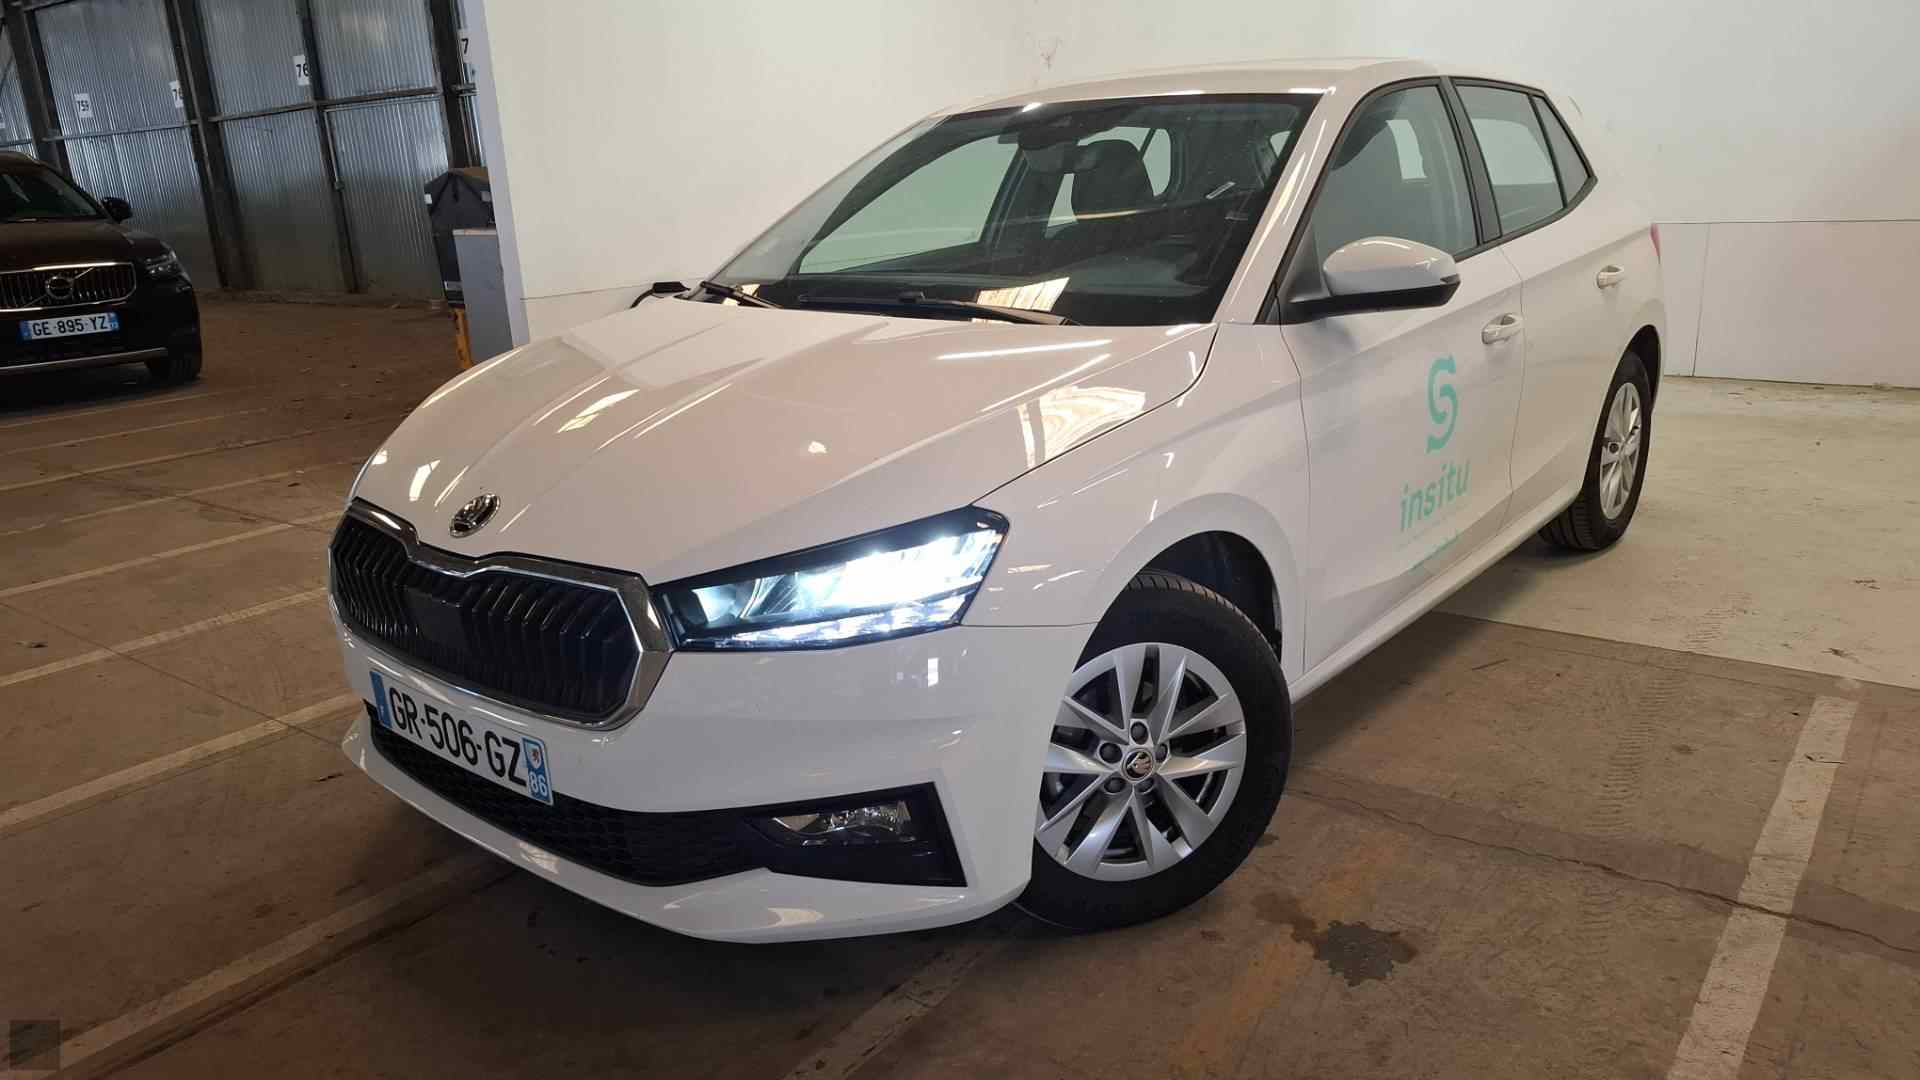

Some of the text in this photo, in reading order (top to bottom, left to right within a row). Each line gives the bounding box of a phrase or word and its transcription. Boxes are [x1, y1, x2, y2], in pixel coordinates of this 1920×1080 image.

[296, 63, 309, 78] 76
[1401, 459, 1470, 532] insitu
[528, 771, 548, 796] 86
